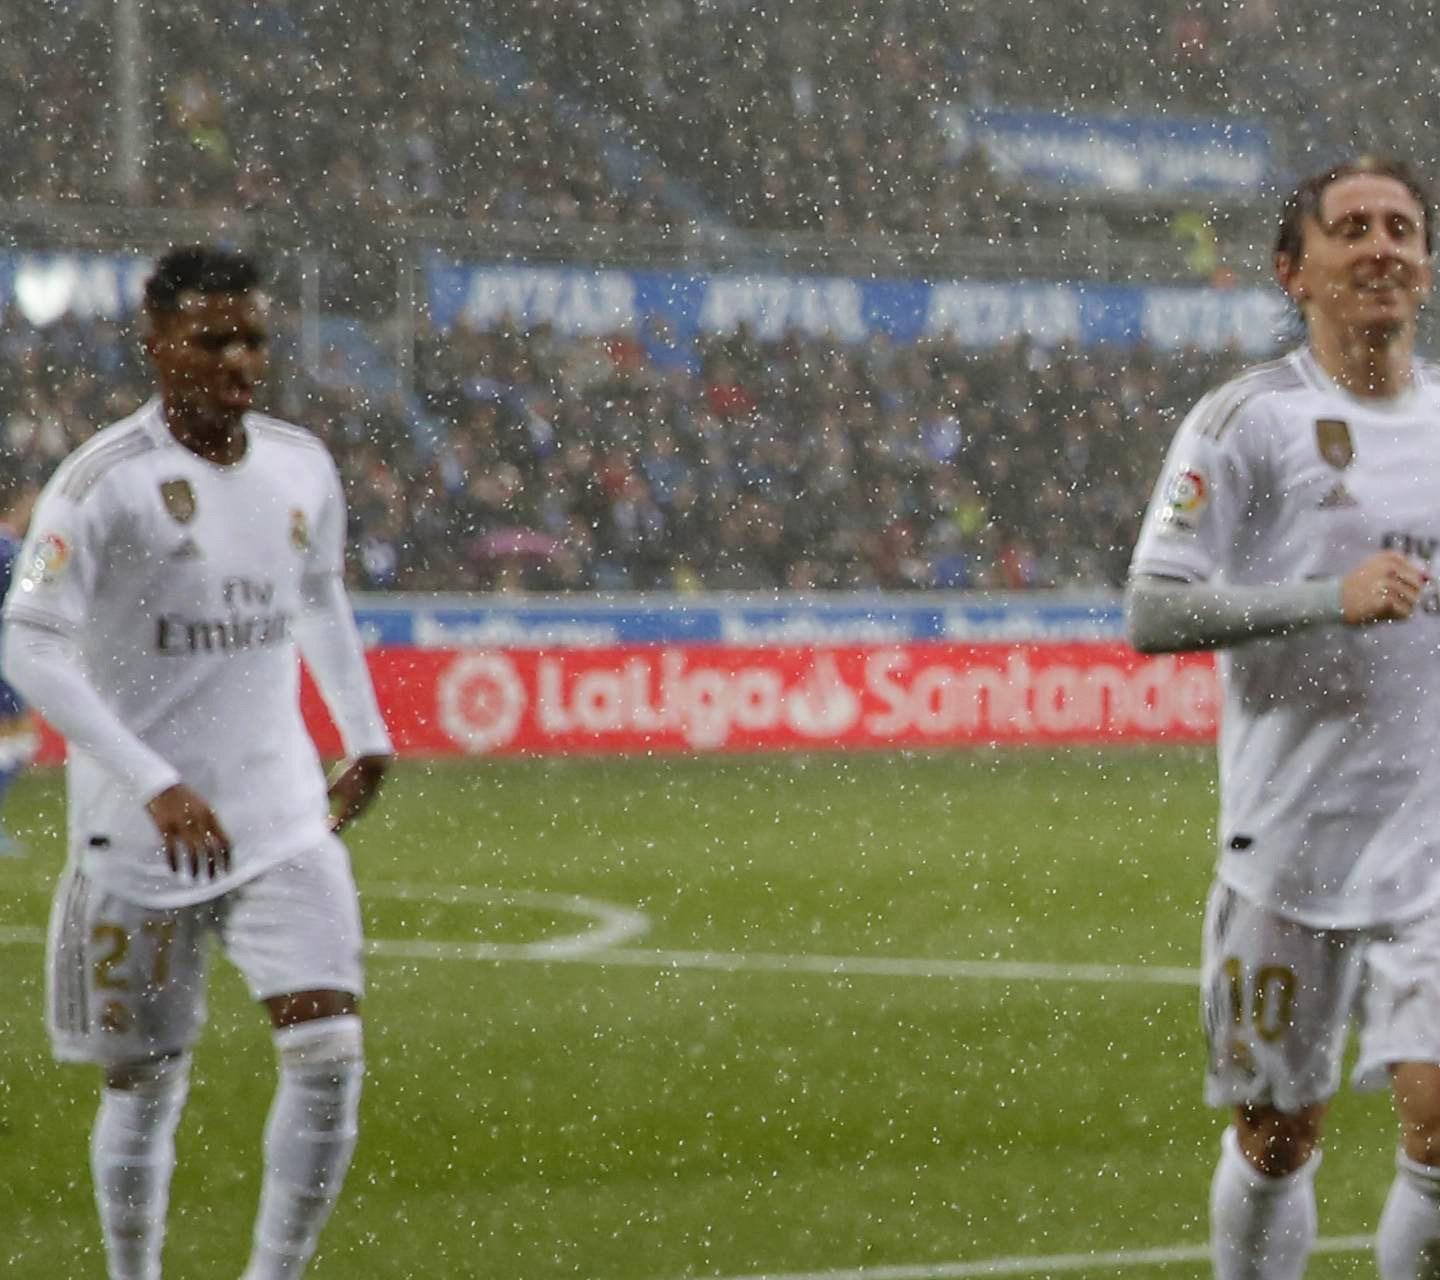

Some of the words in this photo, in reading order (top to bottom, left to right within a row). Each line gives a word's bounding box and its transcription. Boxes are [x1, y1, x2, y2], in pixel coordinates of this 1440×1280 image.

[537, 651, 783, 750] LaLiga
[864, 648, 1222, 738] Santande
[1223, 957, 1298, 1043] 10
